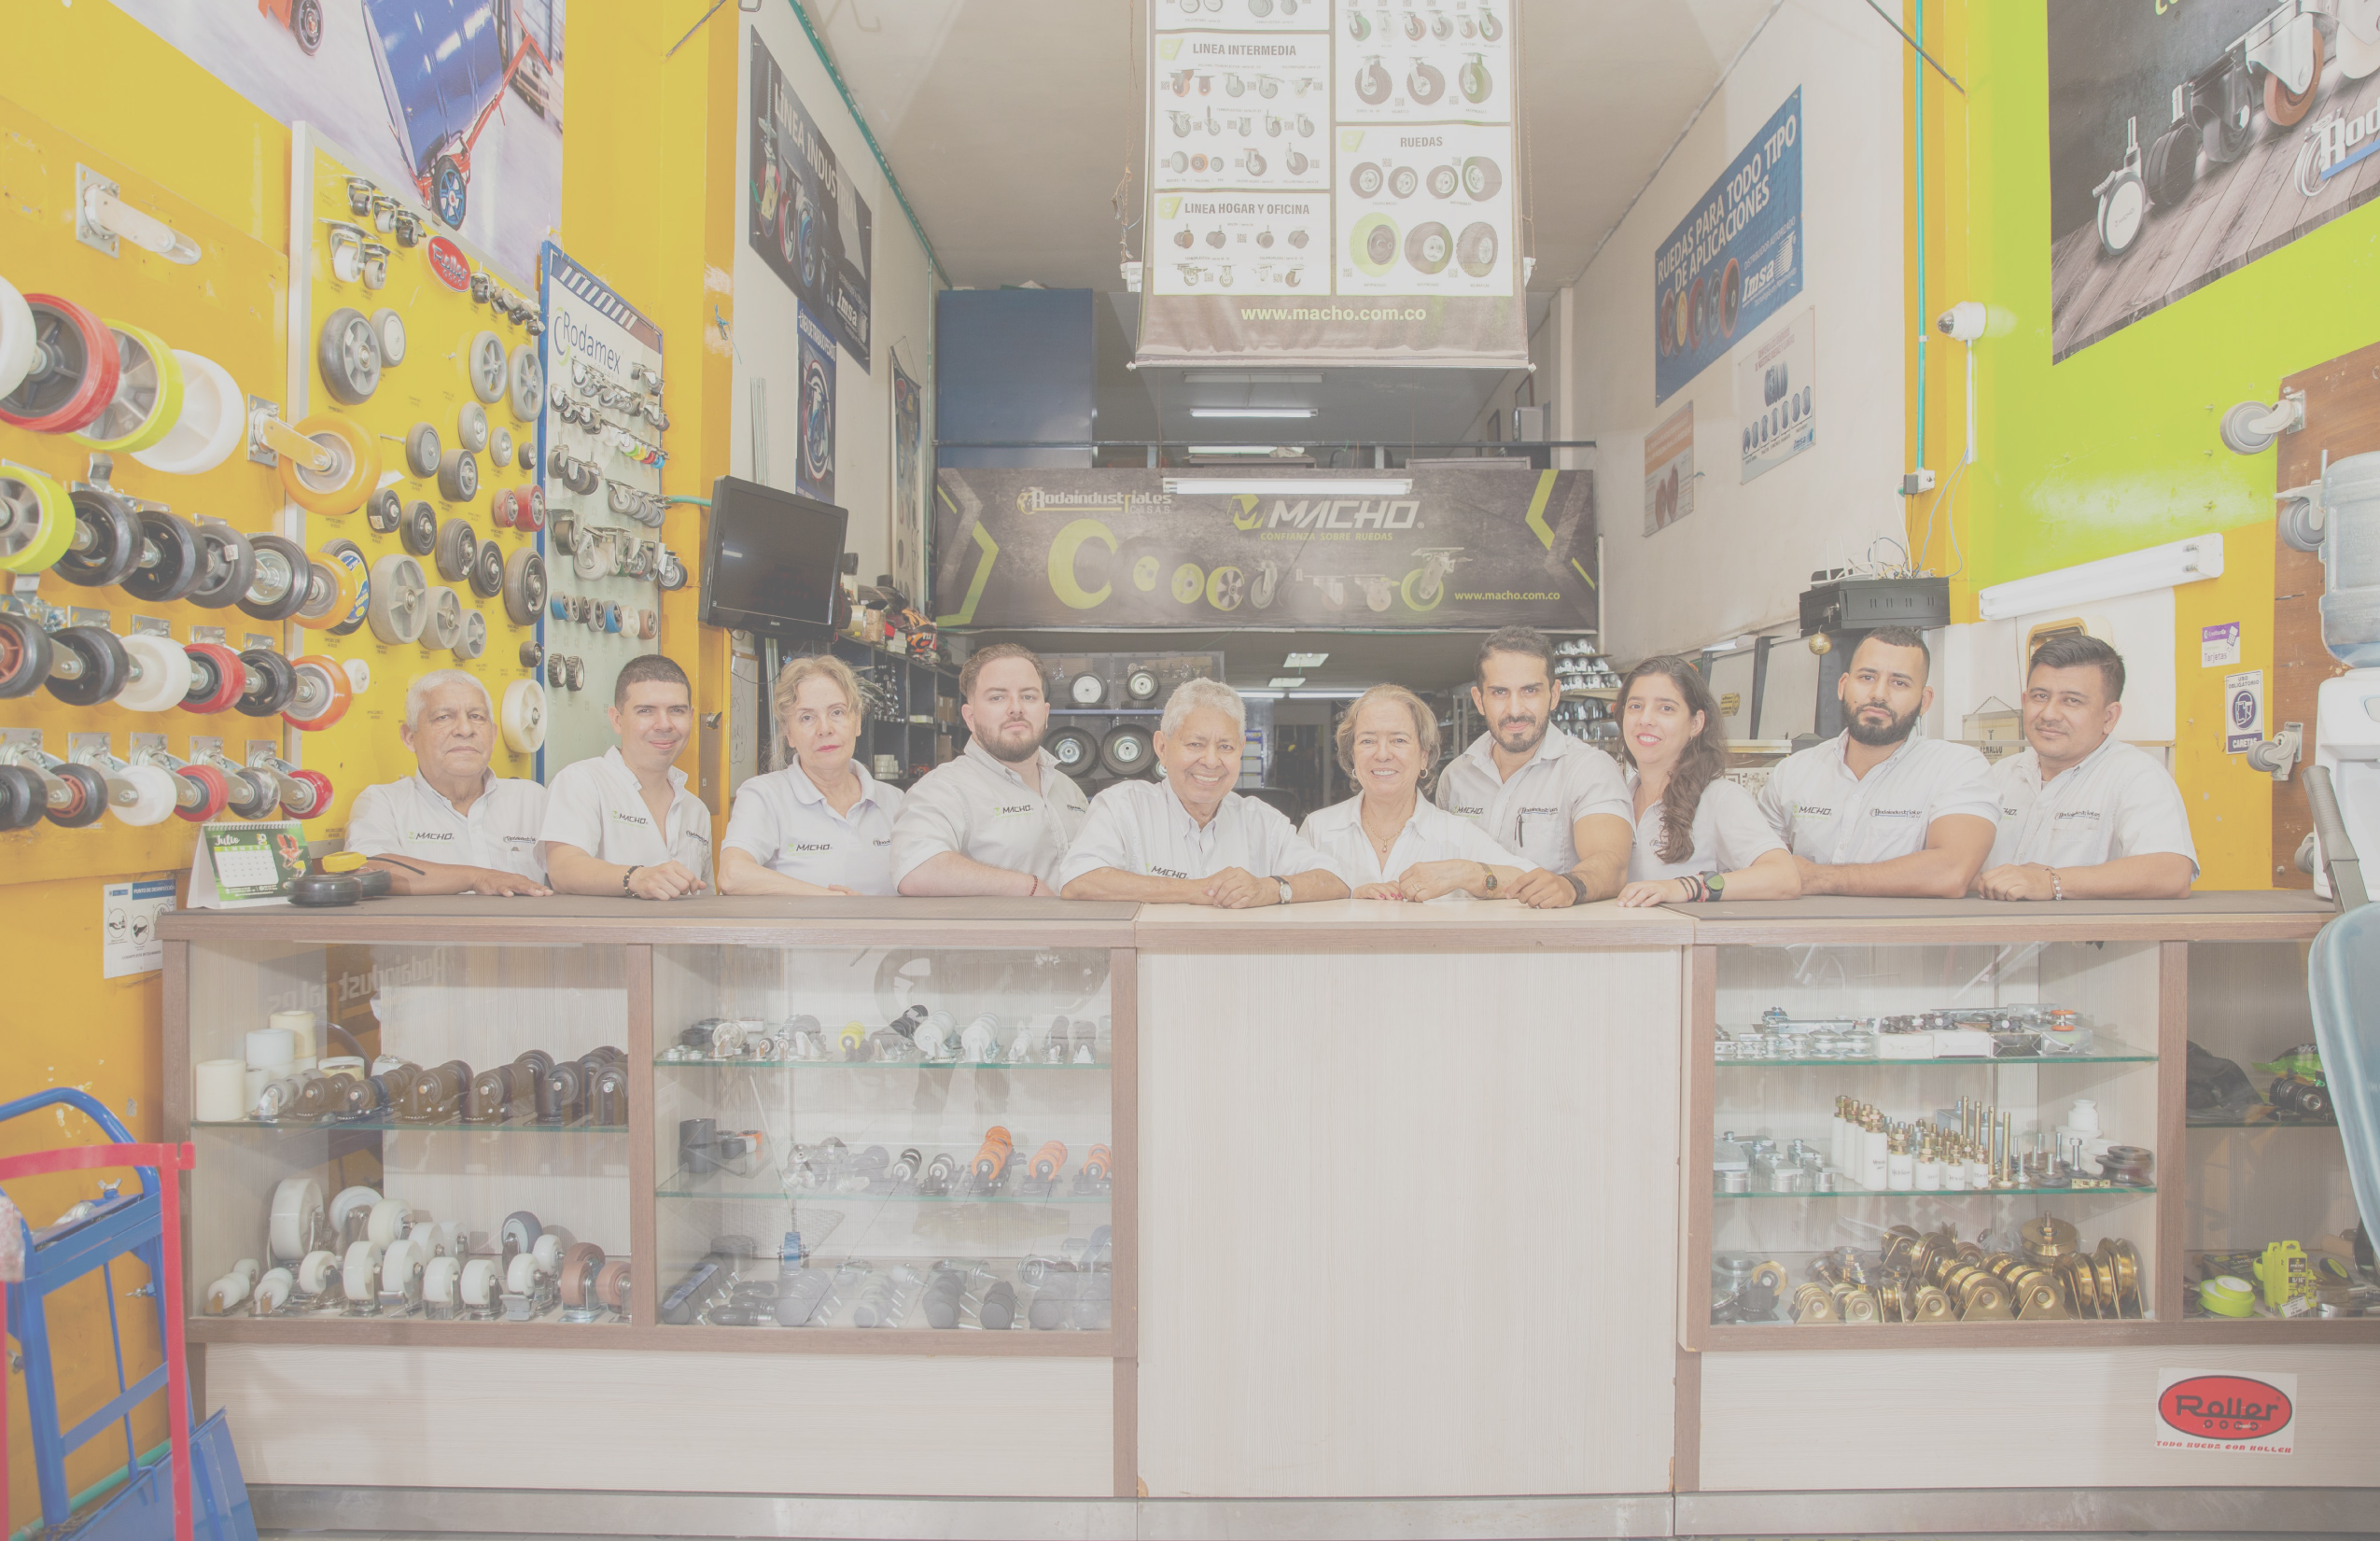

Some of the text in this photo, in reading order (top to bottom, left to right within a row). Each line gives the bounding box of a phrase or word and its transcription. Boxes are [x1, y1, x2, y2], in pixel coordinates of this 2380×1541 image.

[1193, 43, 1297, 56] LINEA INTERMEDIA
[1400, 136, 1443, 147] RUEDAS
[775, 82, 805, 156] LÍNEA
[807, 132, 860, 233] INDUSTRIAL
[1658, 114, 1798, 286] RUEDAS PARA TODO TIPO
[1184, 203, 1310, 215] LINEA HOGAR Y OFICINA
[1675, 175, 1771, 293] DE APLICACIONES
[1240, 304, 1427, 321] www.macho.com.co
[563, 311, 621, 374] Rodamex
[1129, 505, 1146, 514] Cali
[1267, 500, 1421, 529] MACHO
[1260, 532, 1393, 541] CONFIANZA SOBRE RUEDAS
[1454, 590, 1561, 601] www.macho.com.co
[2204, 651, 2228, 664] Tarjetas
[2228, 679, 2260, 690] OBLIGATORIO
[1002, 804, 1031, 815] MACHO
[1799, 806, 1832, 816] MACHO
[619, 812, 647, 825] MACHO
[213, 834, 241, 846] Julio
[415, 832, 454, 840] MACHO
[796, 843, 831, 852] MACHO
[1151, 864, 1187, 880] MACHO
[2176, 1394, 2279, 1422] Roller
[2249, 1445, 2292, 1453] ROLLER
